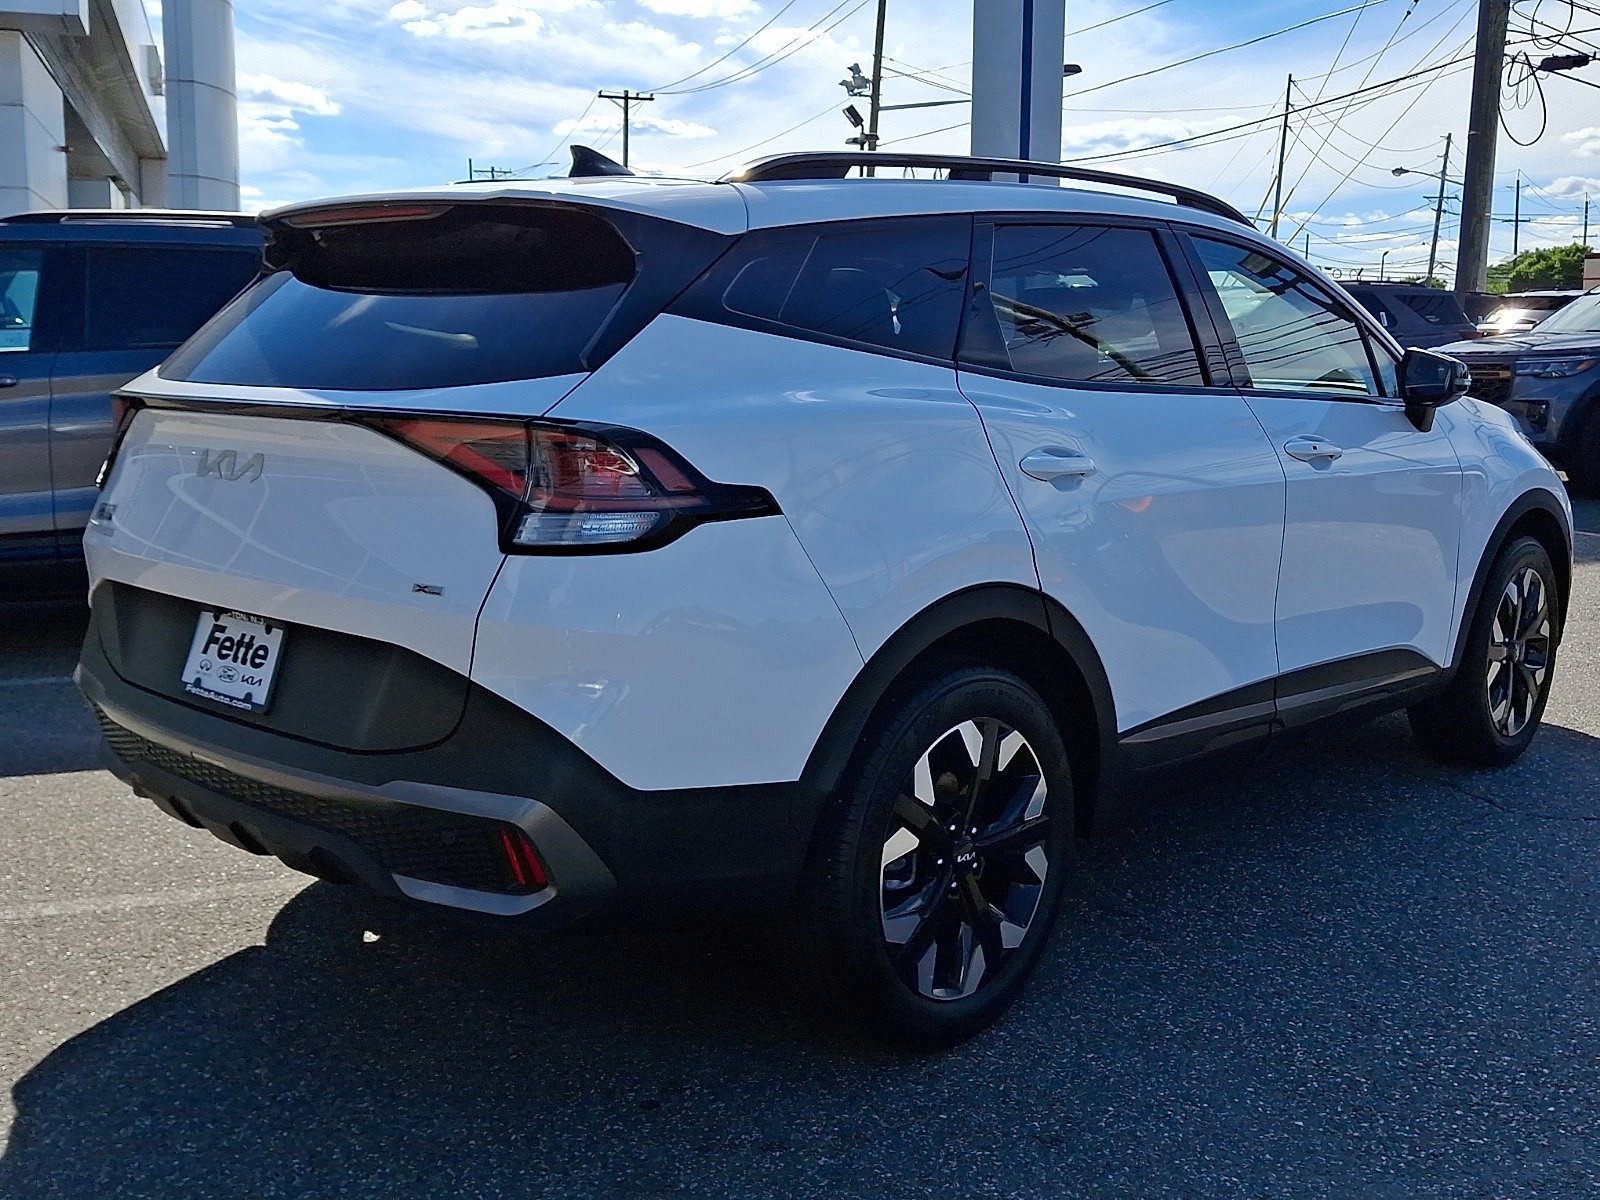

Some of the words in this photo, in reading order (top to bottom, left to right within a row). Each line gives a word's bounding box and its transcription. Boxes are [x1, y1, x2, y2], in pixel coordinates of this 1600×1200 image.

[196, 447, 265, 484] KIA
[201, 623, 269, 669] Fette
[241, 674, 263, 687] KIA
[957, 851, 976, 863] KIA
